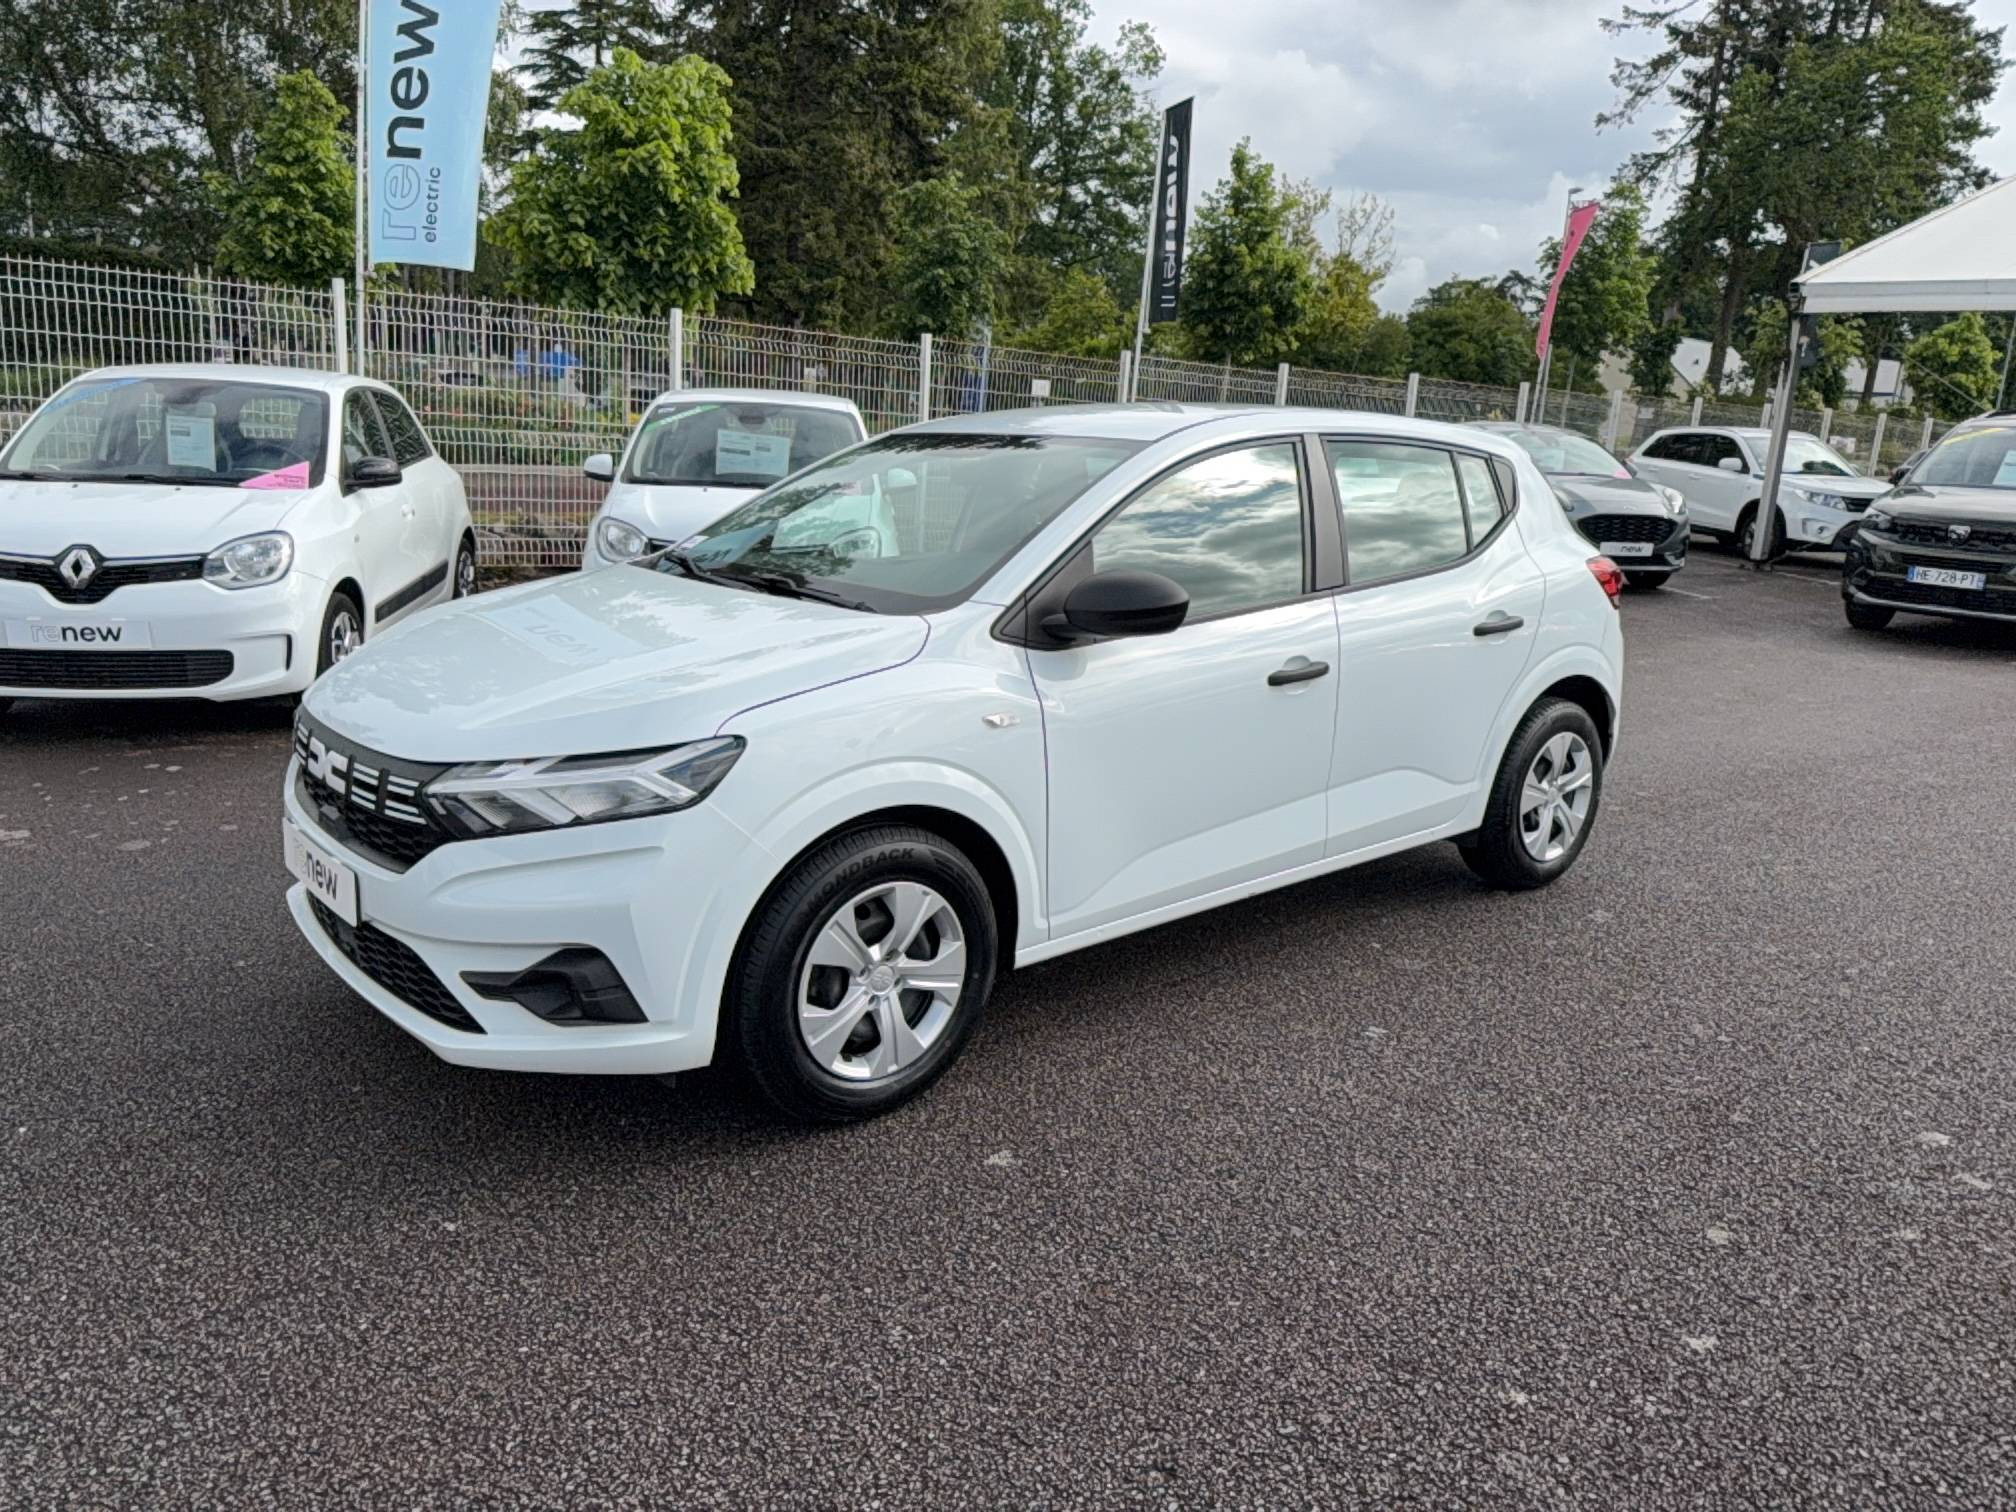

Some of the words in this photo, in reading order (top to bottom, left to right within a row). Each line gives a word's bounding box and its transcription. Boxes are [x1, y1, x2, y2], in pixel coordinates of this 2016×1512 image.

[382, 0, 439, 241] renew
[422, 166, 441, 243] electric
[30, 625, 122, 642] renew
[294, 837, 339, 901] new
